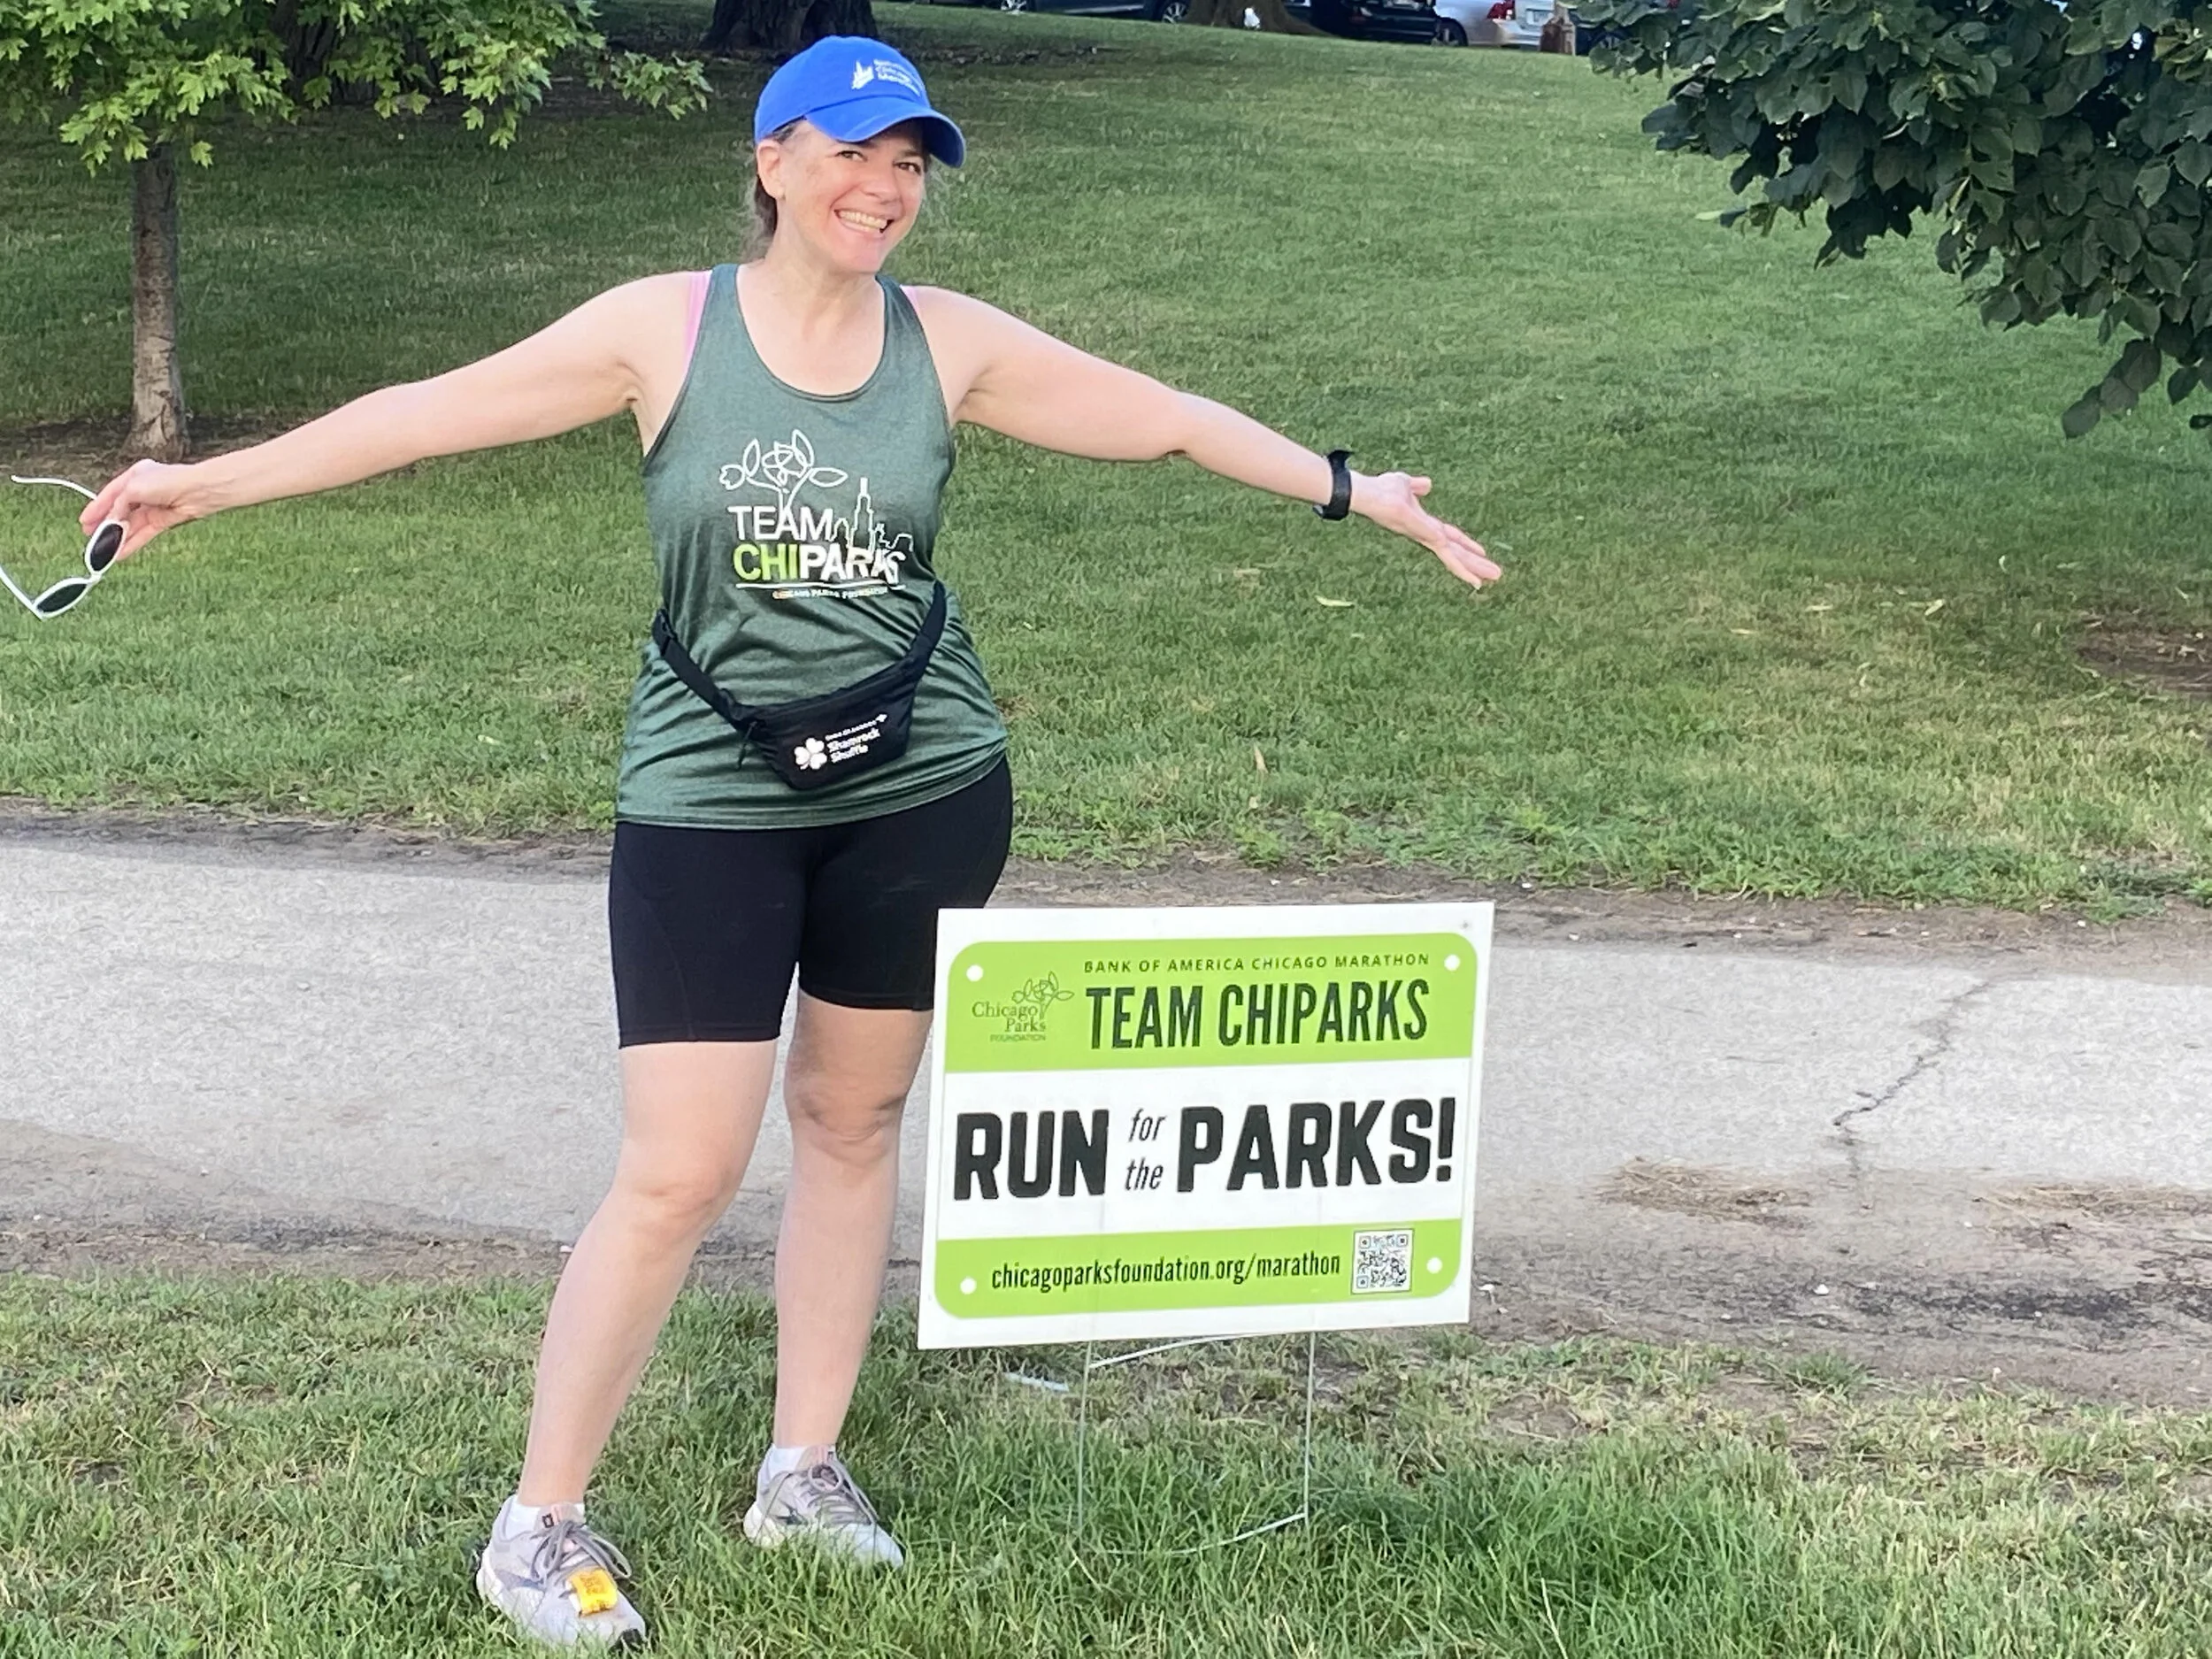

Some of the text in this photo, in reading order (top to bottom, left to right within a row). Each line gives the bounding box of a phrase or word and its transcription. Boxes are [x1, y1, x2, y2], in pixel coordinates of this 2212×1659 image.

[727, 505, 833, 541] TEAM
[1084, 953, 1430, 973] BANK OF AMERICA CHICAGO MARATHON
[972, 1001, 1038, 1021] Chicago
[1004, 1017, 1046, 1033] Parks
[1086, 979, 1430, 1049] TEAM CHIPARKS
[954, 1097, 1455, 1201] RUN for the PARKS!
[992, 1250, 1340, 1294] chicagoparksfoundation.org/marathon
